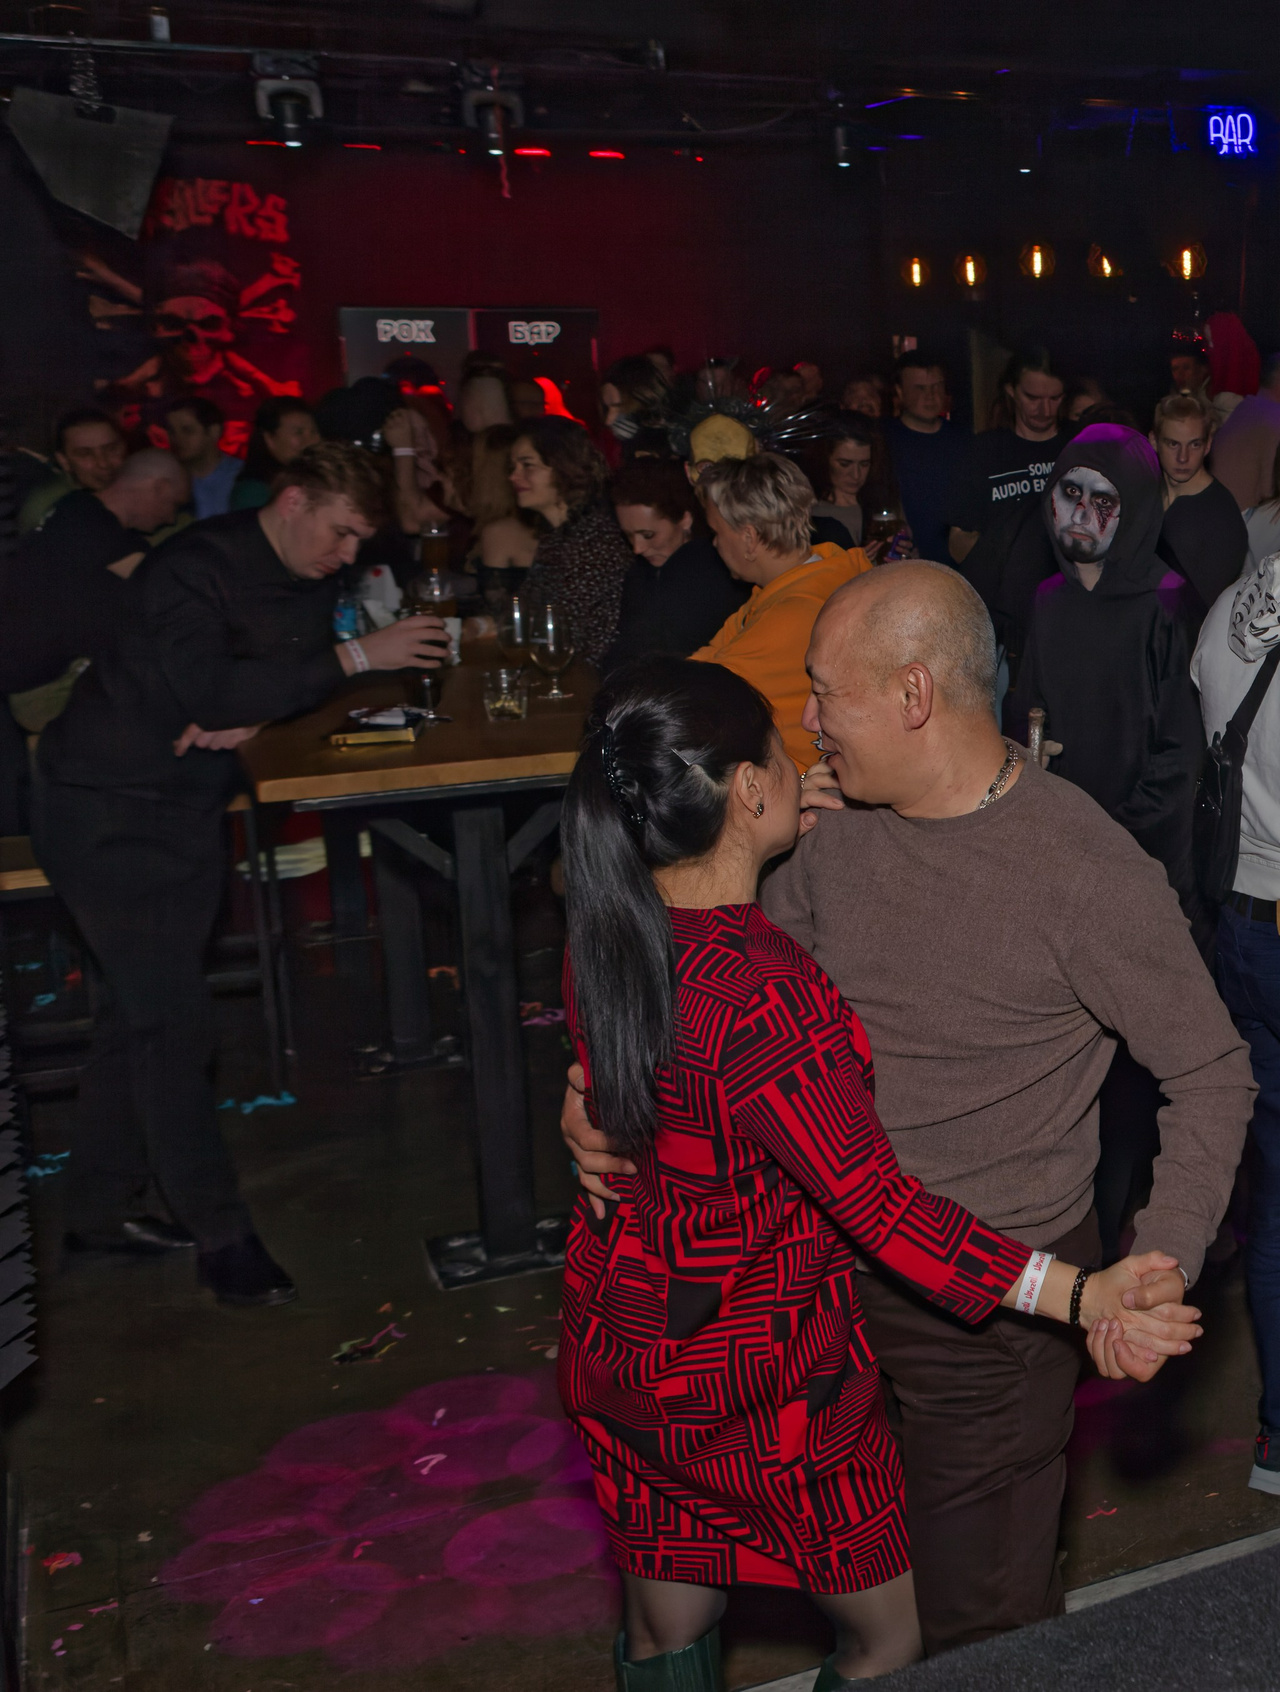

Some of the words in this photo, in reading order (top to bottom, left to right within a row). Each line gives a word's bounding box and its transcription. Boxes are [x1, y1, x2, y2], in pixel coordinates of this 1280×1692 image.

[1209, 113, 1254, 154] BAR
[376, 318, 436, 343] РОК
[508, 320, 561, 346] БАР
[1028, 462, 1056, 477] SOM
[992, 480, 1031, 501] AUDIO
